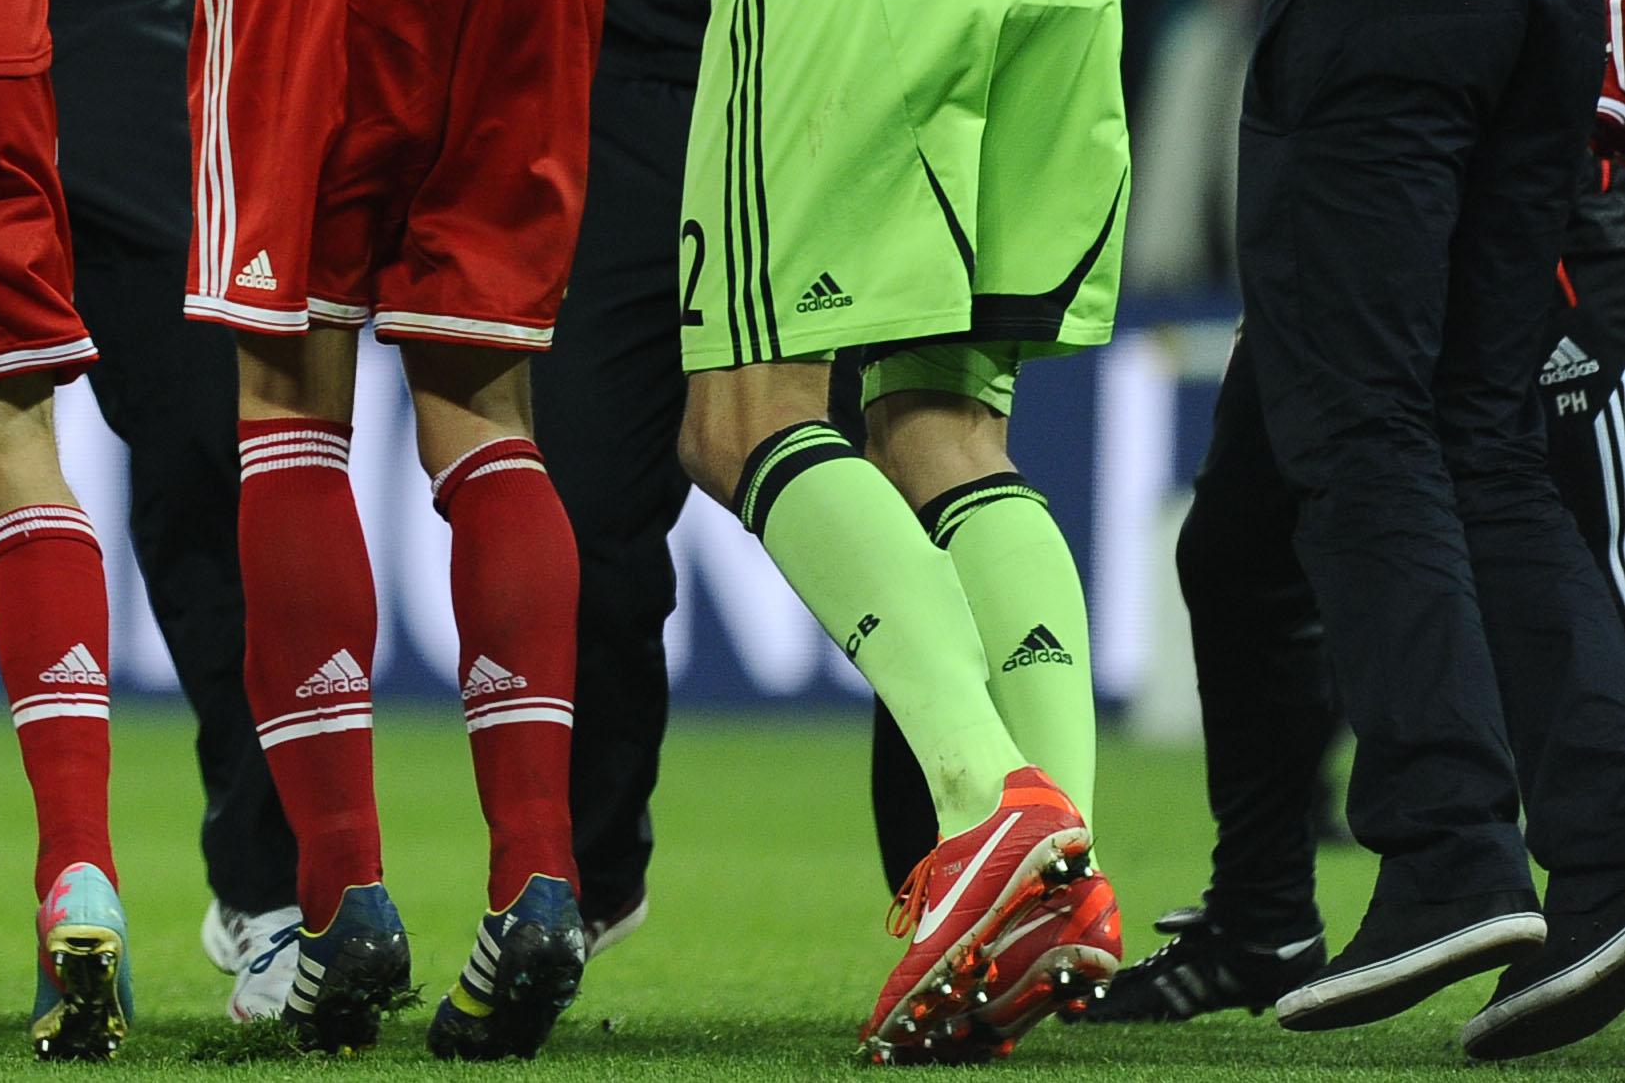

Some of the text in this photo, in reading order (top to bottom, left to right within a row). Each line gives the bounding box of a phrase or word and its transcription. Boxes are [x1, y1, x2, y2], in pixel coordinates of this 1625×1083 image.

[235, 273, 277, 291] adidas
[680, 218, 706, 327] 2
[796, 293, 853, 313] adidas
[1539, 359, 1600, 385] adidas
[1557, 389, 1588, 417] PH
[1002, 648, 1073, 673] adidas
[38, 669, 108, 687] adidas
[295, 676, 369, 698] adidas
[460, 674, 528, 700] adidas
